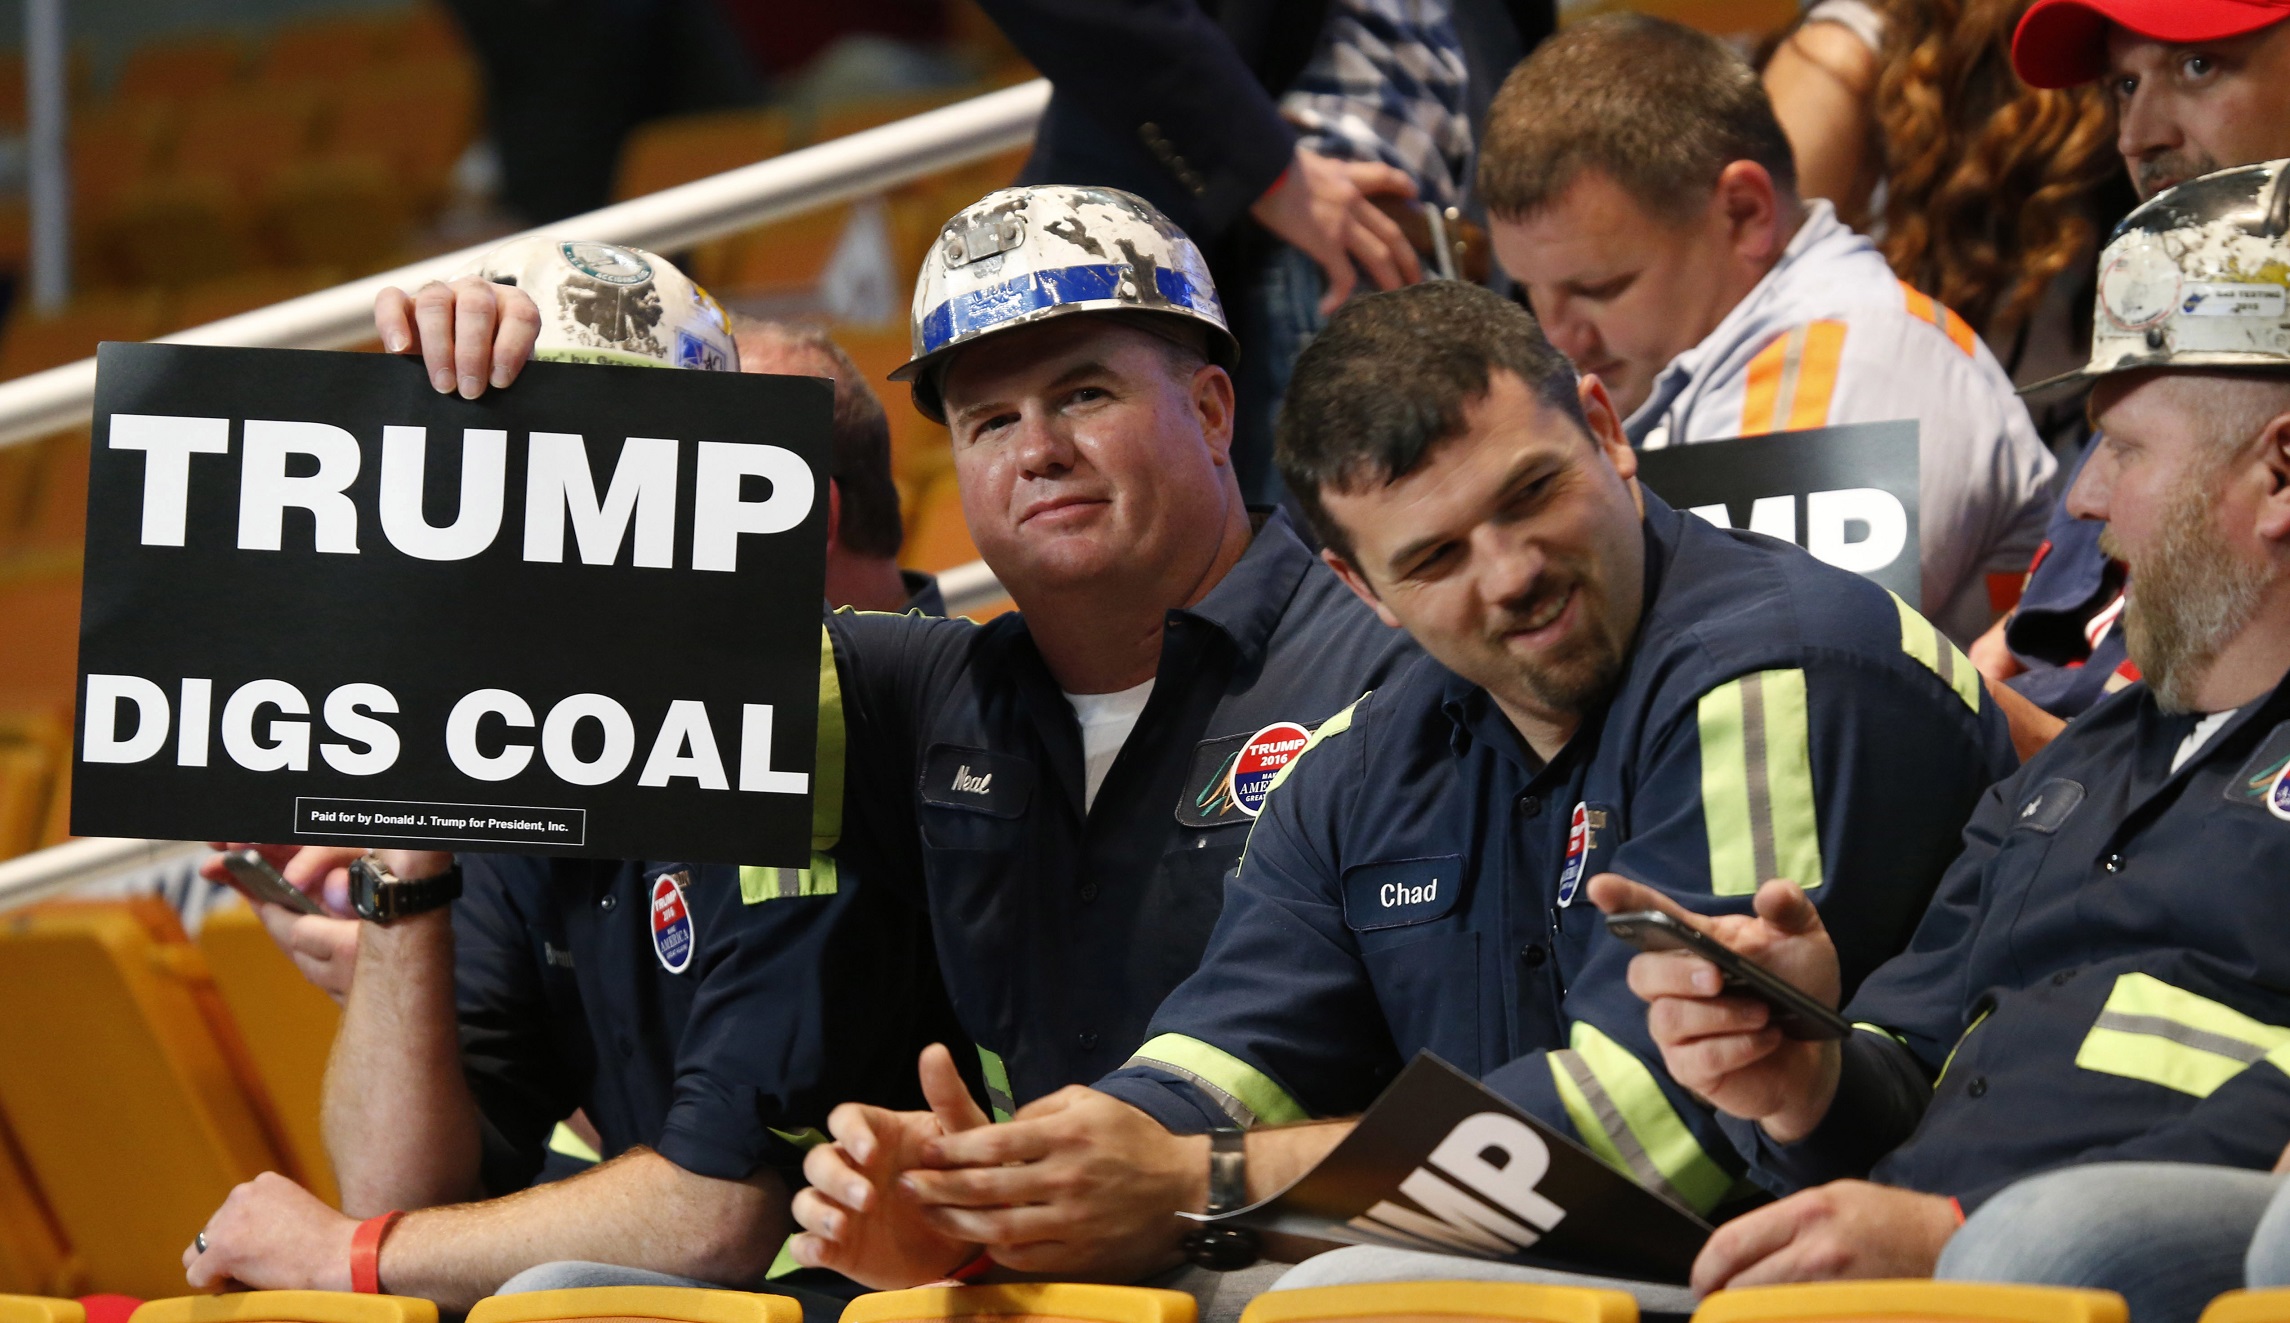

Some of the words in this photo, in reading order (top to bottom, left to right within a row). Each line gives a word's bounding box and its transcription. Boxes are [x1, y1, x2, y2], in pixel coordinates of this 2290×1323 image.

[109, 414, 815, 573] TRUMP
[83, 674, 400, 775] DIGS
[446, 689, 809, 795] COAL
[1249, 738, 1306, 756] TRUMP
[1260, 753, 1289, 767] 2016
[951, 764, 993, 795] Neal
[1261, 771, 1278, 781] MAK
[310, 810, 337, 822] Paid
[338, 812, 356, 823] for
[357, 813, 373, 826] by
[374, 813, 415, 825] Donald
[417, 815, 428, 826] J.
[430, 816, 467, 830] Trump
[468, 818, 487, 828] for
[488, 819, 546, 833] President,
[548, 821, 569, 832] Inc.
[654, 888, 678, 912] TRUMP
[1380, 878, 1438, 908] Chad
[659, 928, 690, 953] AMERICA
